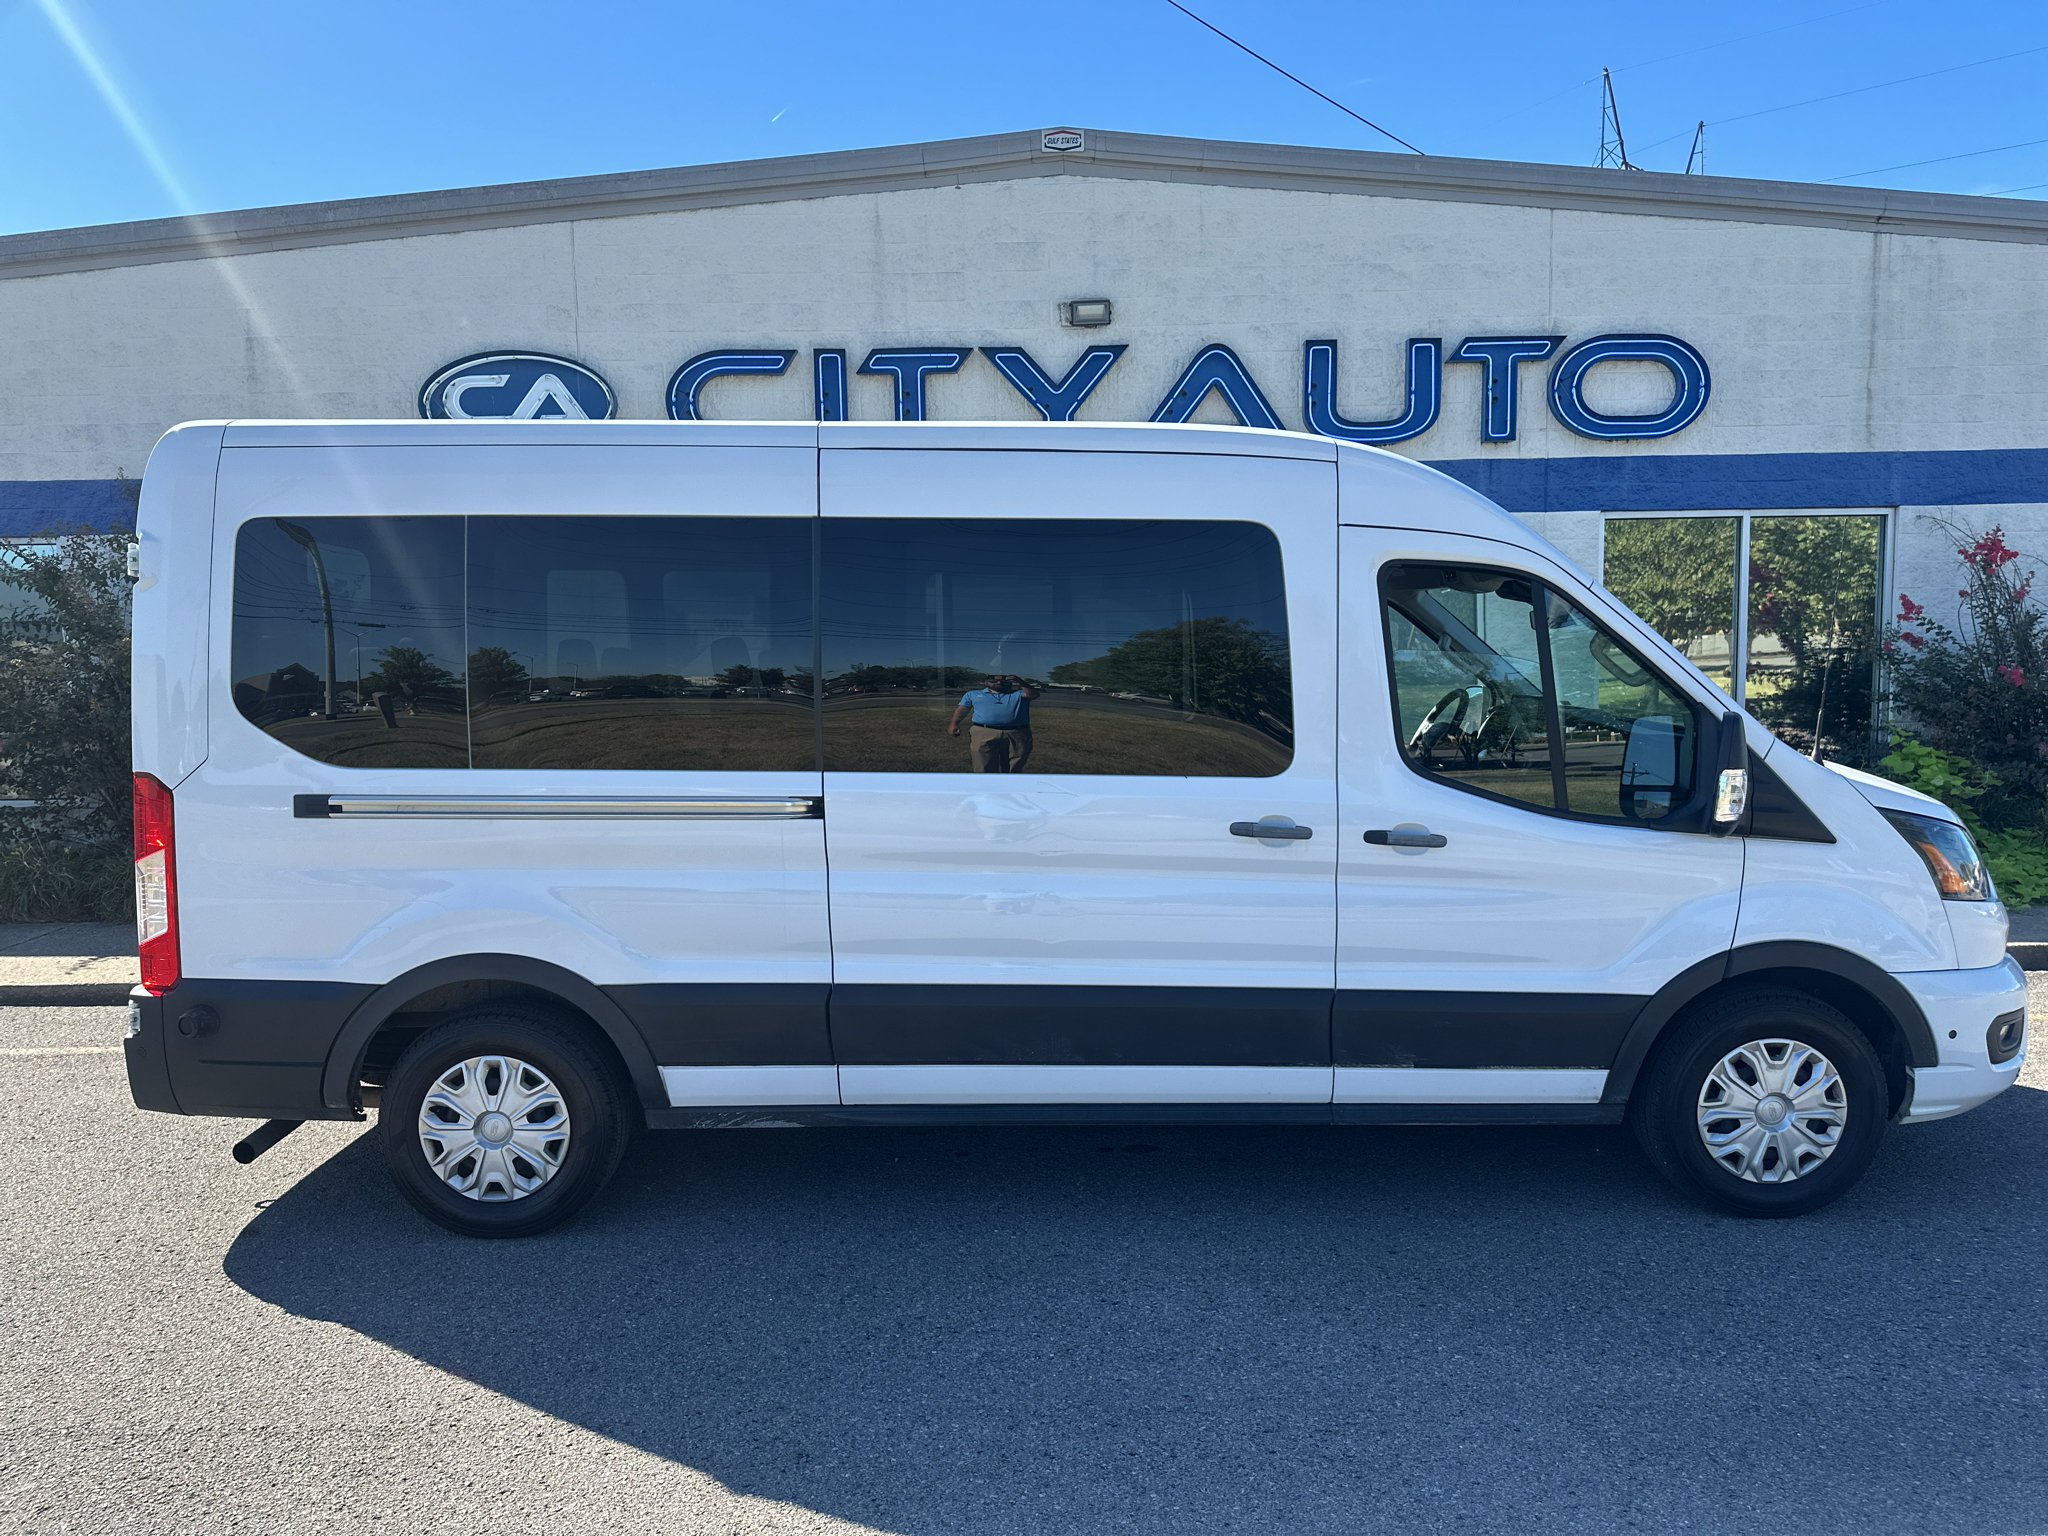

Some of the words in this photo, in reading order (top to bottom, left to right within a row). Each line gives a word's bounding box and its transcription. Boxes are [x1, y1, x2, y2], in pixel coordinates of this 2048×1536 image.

[1047, 137, 1060, 145] GULF
[443, 373, 590, 420] CA
[665, 344, 1129, 421] CITY
[1148, 333, 1711, 443] AUTO
